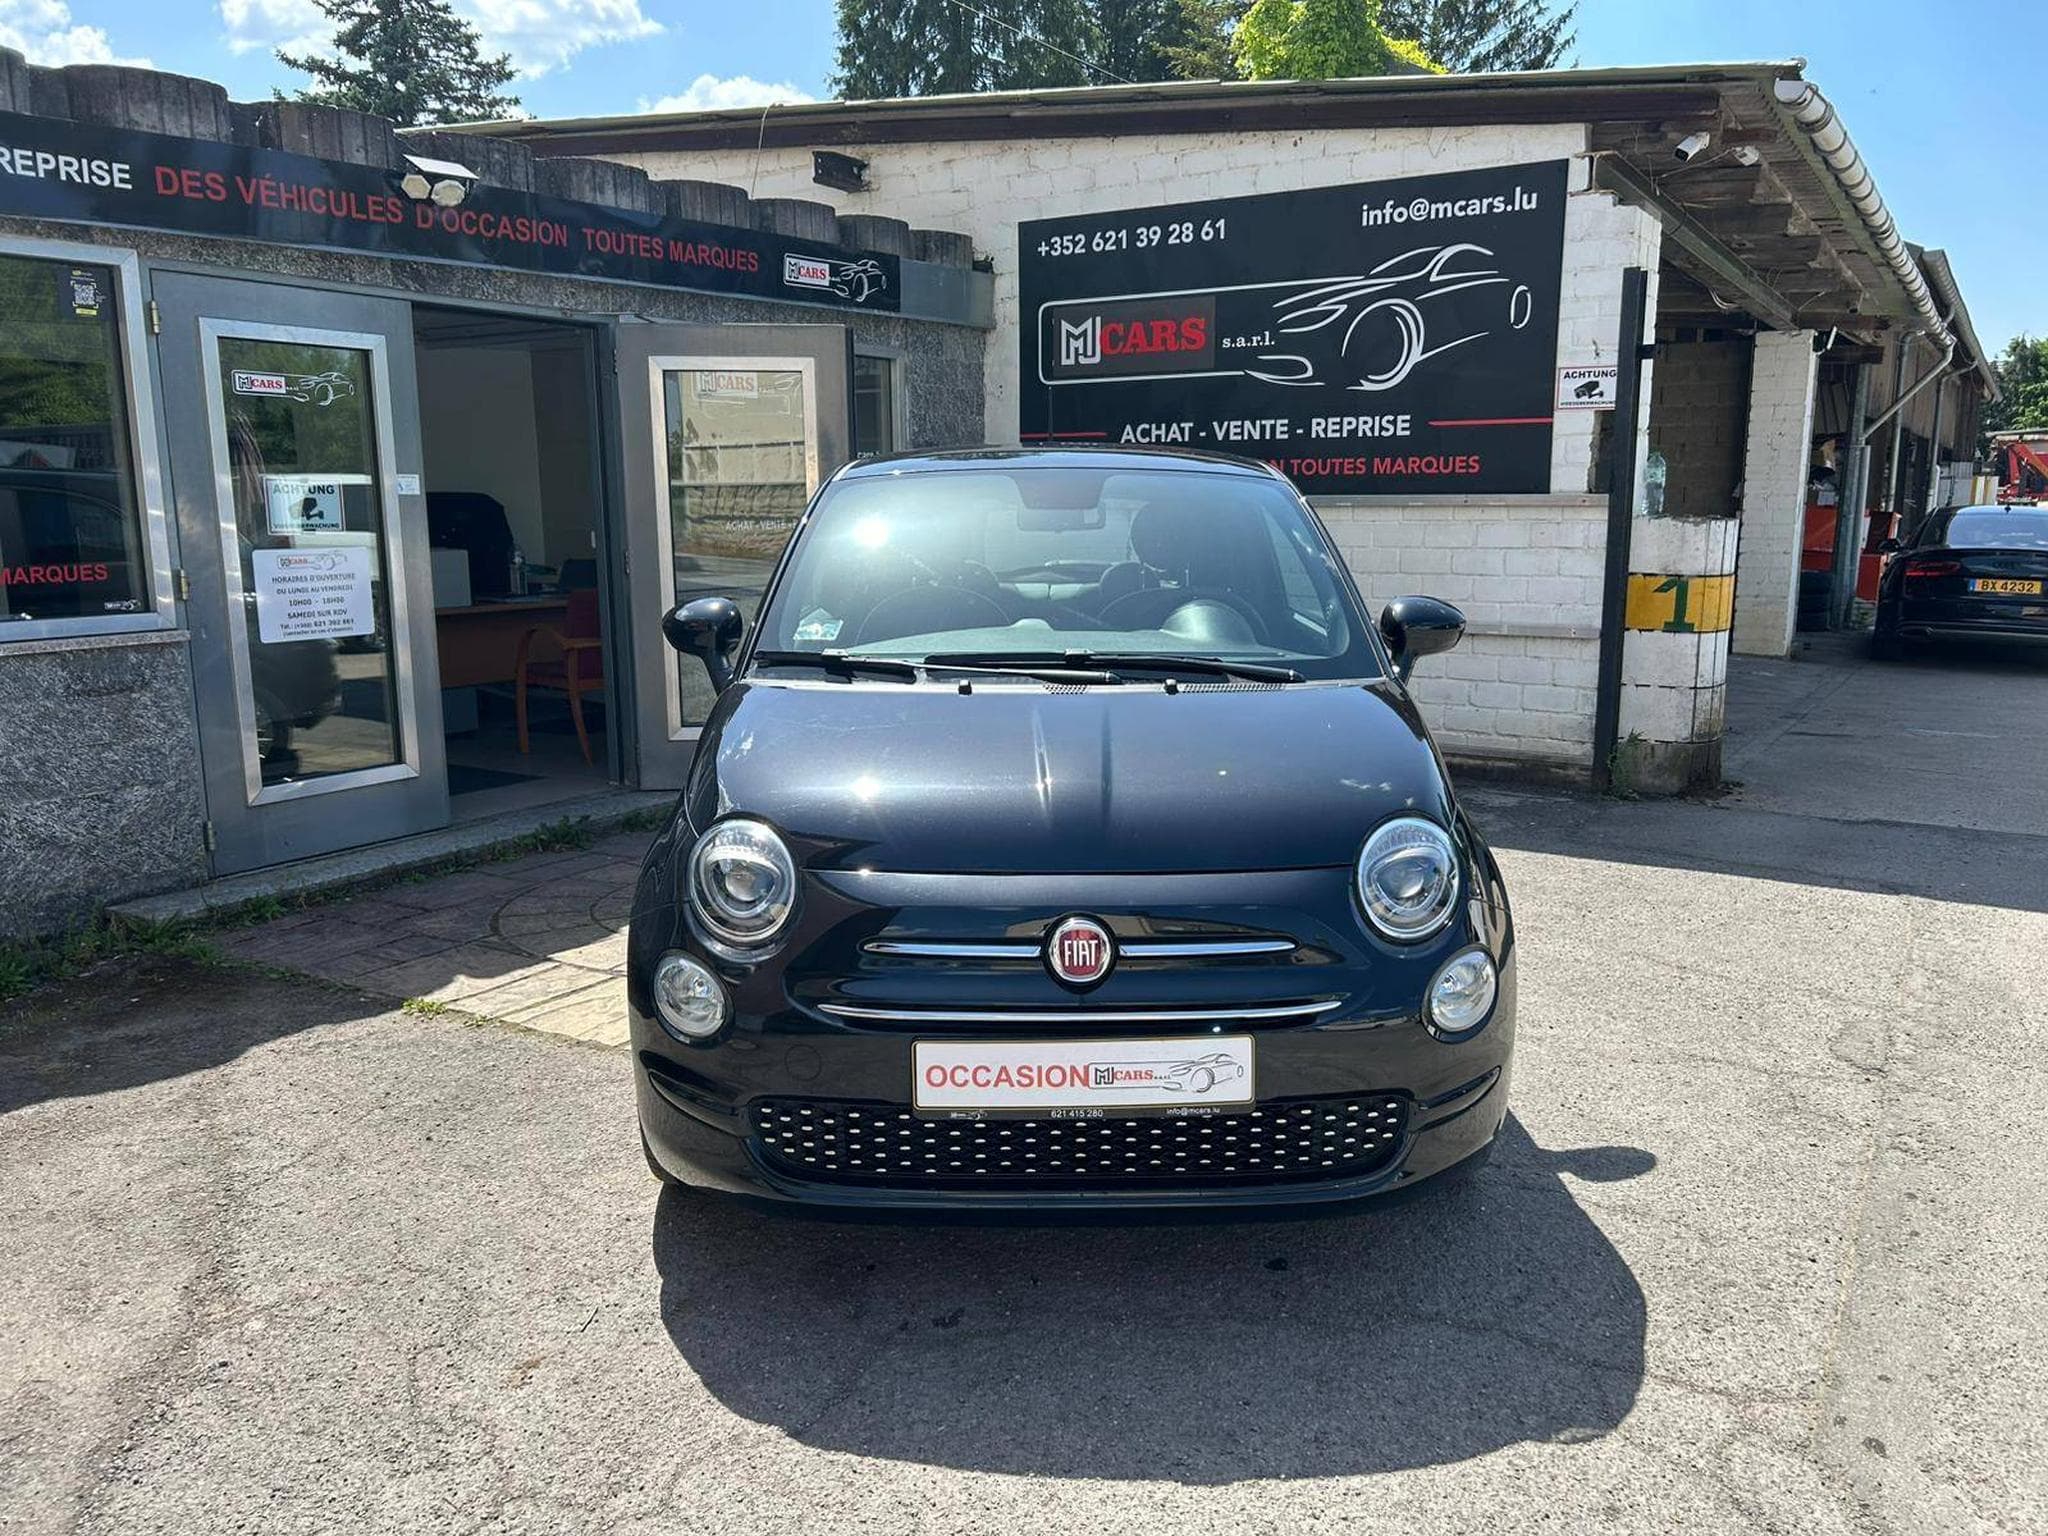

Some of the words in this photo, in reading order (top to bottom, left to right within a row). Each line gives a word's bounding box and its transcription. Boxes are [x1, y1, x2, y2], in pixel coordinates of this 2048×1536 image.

[0, 146, 132, 190] REPRISE
[155, 166, 227, 201] DES
[235, 173, 404, 223] VÉHICULES
[416, 203, 568, 247] D'OCCASION
[582, 227, 664, 259] TOUTES
[669, 240, 758, 272] MARQUES
[1361, 186, 1537, 226] info@mcars.lu
[1037, 234, 1086, 256] +352
[1092, 229, 1128, 252] 621
[1136, 226, 1161, 248] 39
[1167, 222, 1194, 244] 28
[1200, 218, 1225, 241] 61
[1222, 331, 1275, 348] s.a.r.l.
[1564, 369, 1616, 379] ACHTUNG
[1120, 422, 1193, 444] ACHAT
[1213, 419, 1289, 440] VENTE
[1311, 415, 1411, 438] REPRISE
[1290, 457, 1366, 476] TOUTES
[1373, 455, 1480, 475] MARQUES
[273, 484, 335, 495] ACHTUNG
[0, 564, 108, 585] MARQUES
[1982, 580, 1997, 590] BX
[2001, 582, 2034, 592] 4232
[1652, 578, 1695, 632] 1
[1064, 940, 1098, 967] FIAT
[926, 1065, 1088, 1088] OCCASION
[1051, 1110, 1067, 1118] 621
[1069, 1110, 1085, 1118] 415
[1086, 1109, 1103, 1118] 280
